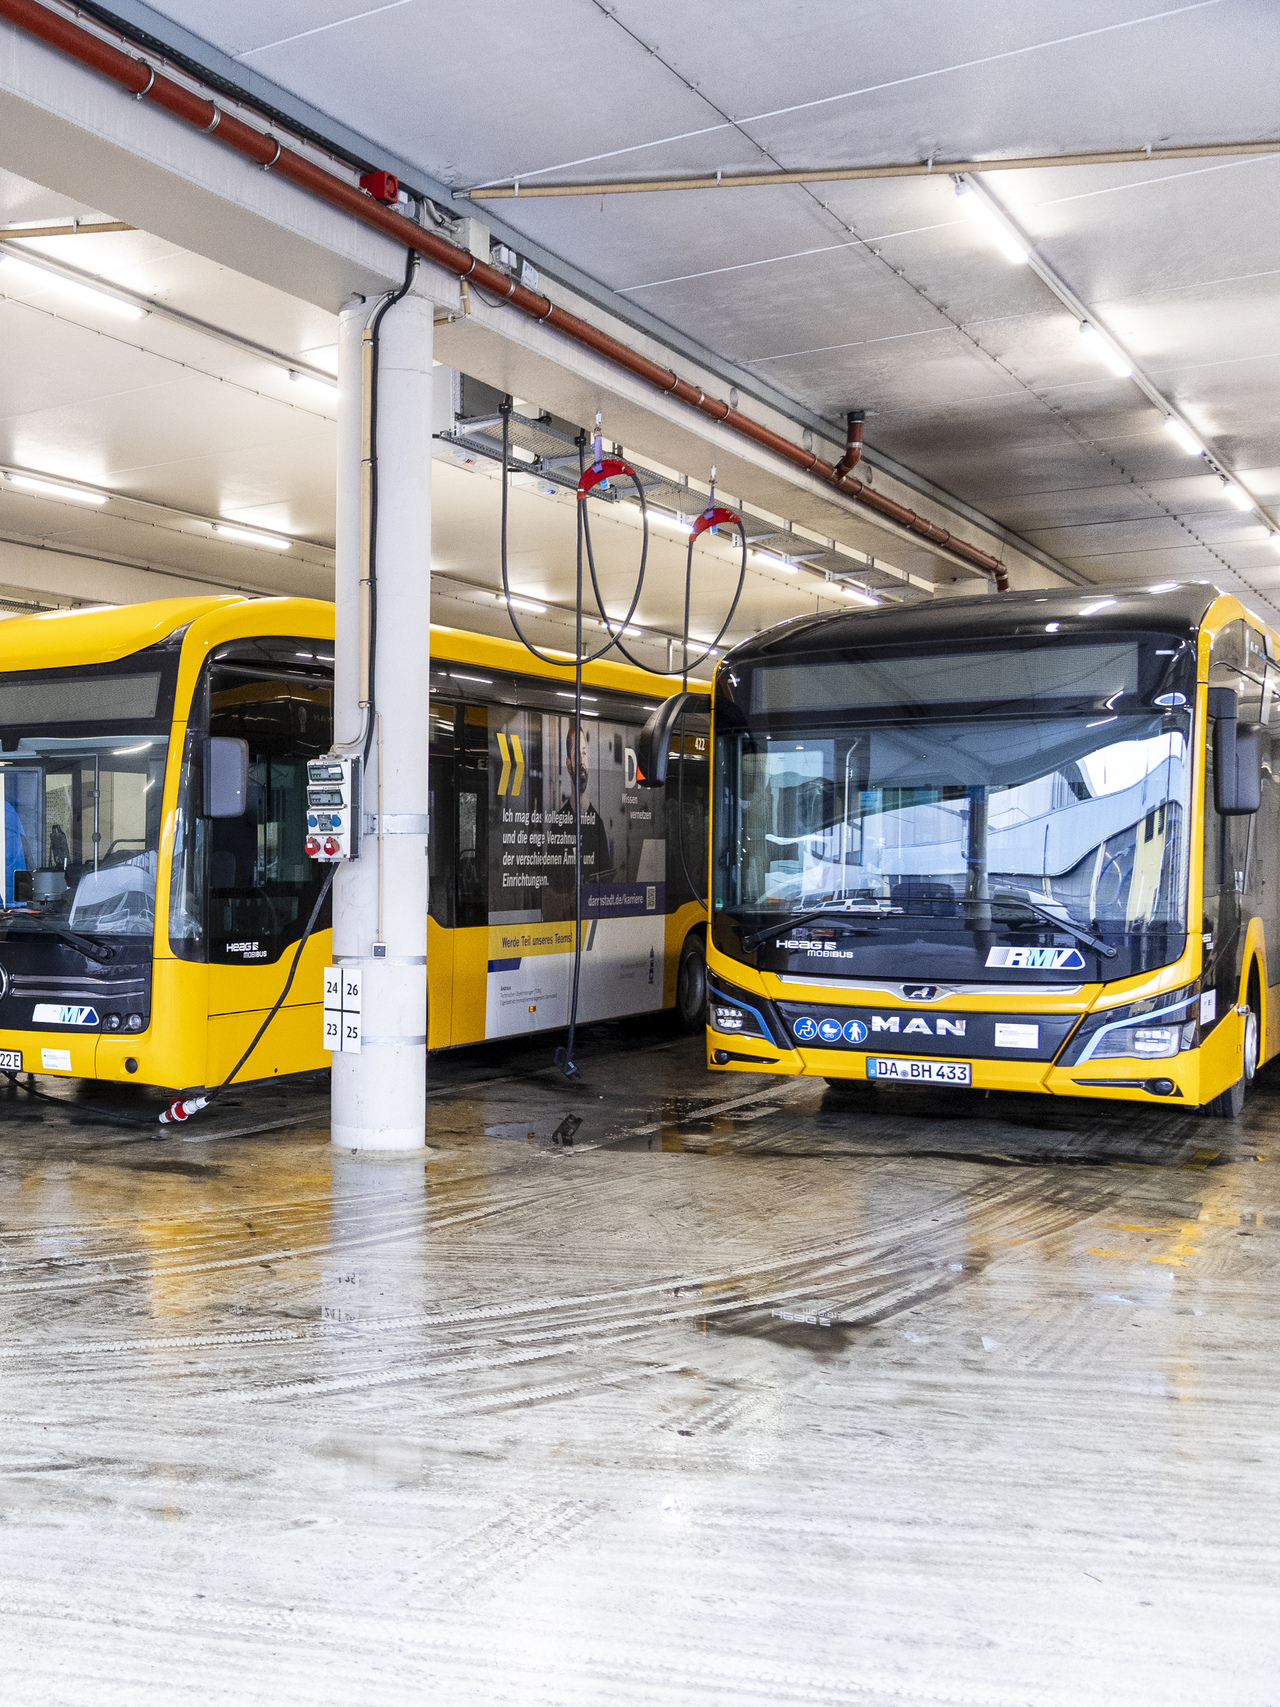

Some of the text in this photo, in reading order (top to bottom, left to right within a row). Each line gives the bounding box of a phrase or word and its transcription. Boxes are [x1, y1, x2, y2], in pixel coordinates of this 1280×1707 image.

[694, 737, 706, 751] 422
[502, 808, 596, 827] Ich mag das kollegiale mfeld
[502, 830, 516, 844] und
[517, 830, 528, 844] die
[529, 833, 545, 847] enge
[502, 851, 515, 866] der
[516, 851, 562, 866] verschiedenen
[583, 851, 595, 865] und
[502, 872, 550, 889] Einrichtungen.
[501, 932, 573, 949] Werde Teil unseres Teams!
[807, 949, 854, 959] MOBIBUS
[1004, 948, 1074, 967] RMV
[326, 981, 359, 996] 24 26
[326, 1023, 358, 1039] 23 25
[871, 1015, 967, 1037] MAN
[878, 1061, 899, 1076] DA
[910, 1063, 932, 1079] BH
[936, 1065, 967, 1081] 433
